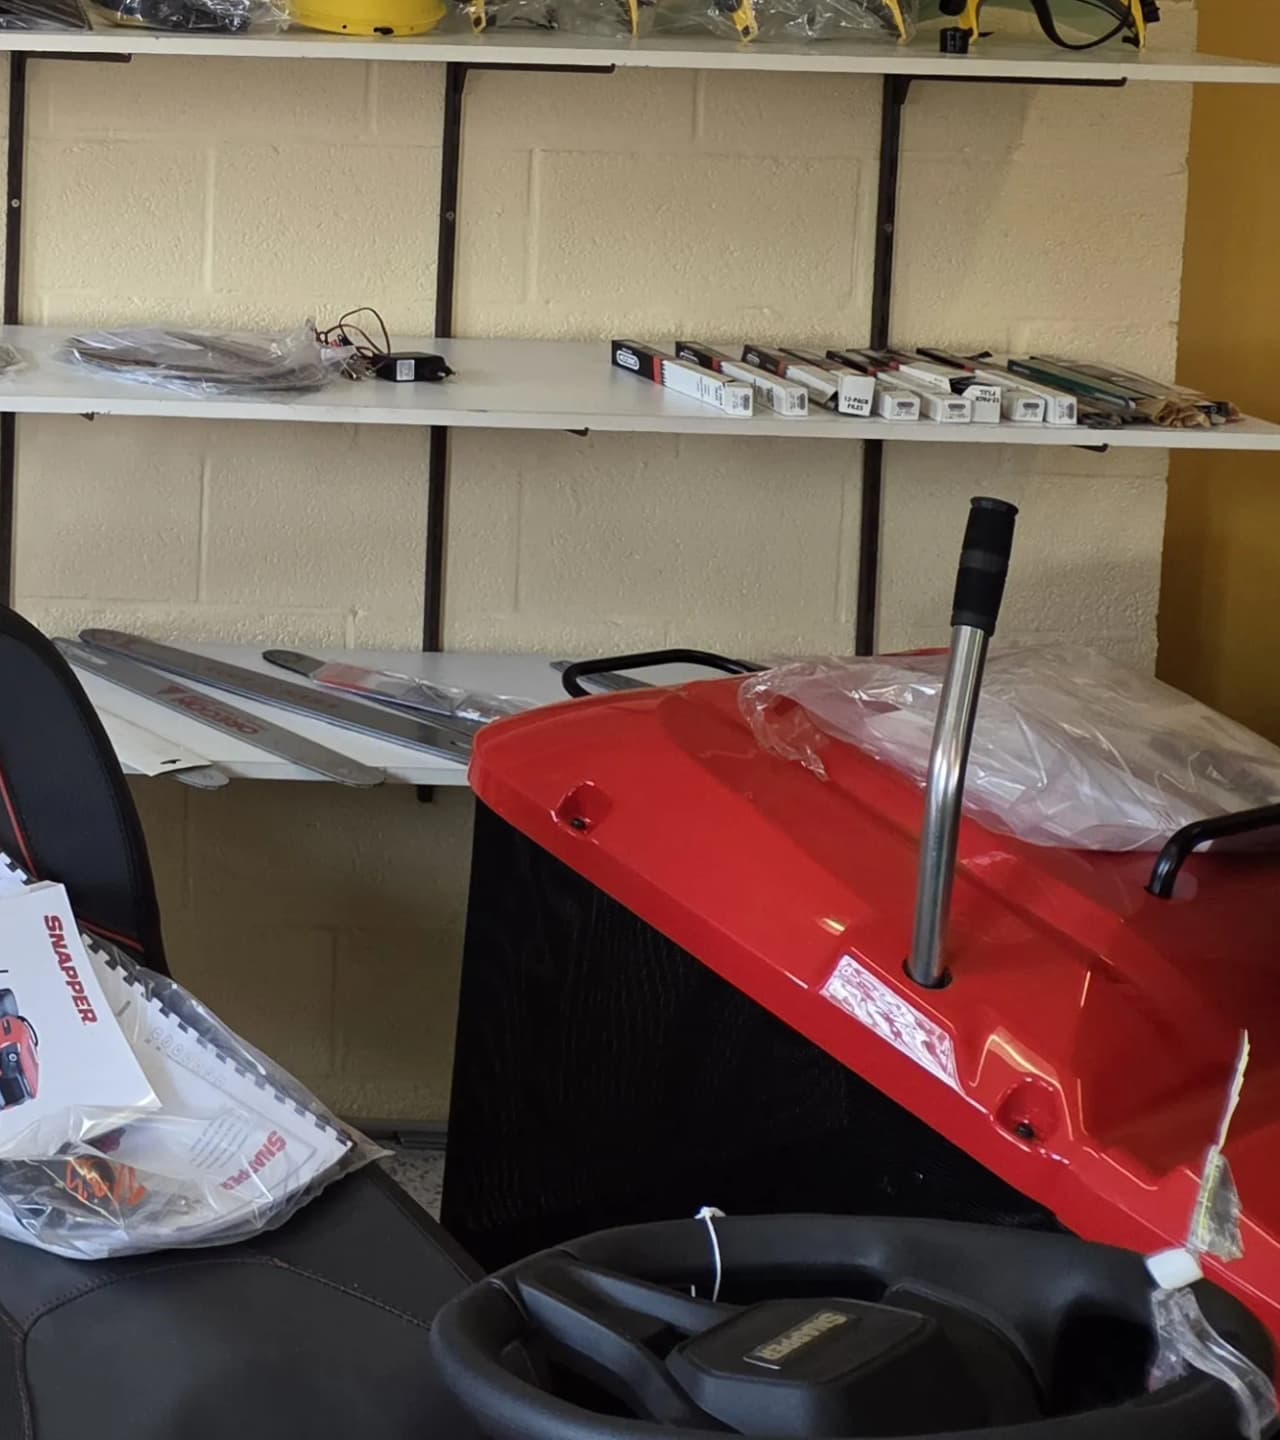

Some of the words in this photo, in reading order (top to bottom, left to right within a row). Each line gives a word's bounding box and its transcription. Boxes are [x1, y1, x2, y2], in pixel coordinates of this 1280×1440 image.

[846, 404, 865, 412] FILES
[43, 915, 98, 1025] SNAPPER
[220, 1129, 288, 1191] SNAPPER
